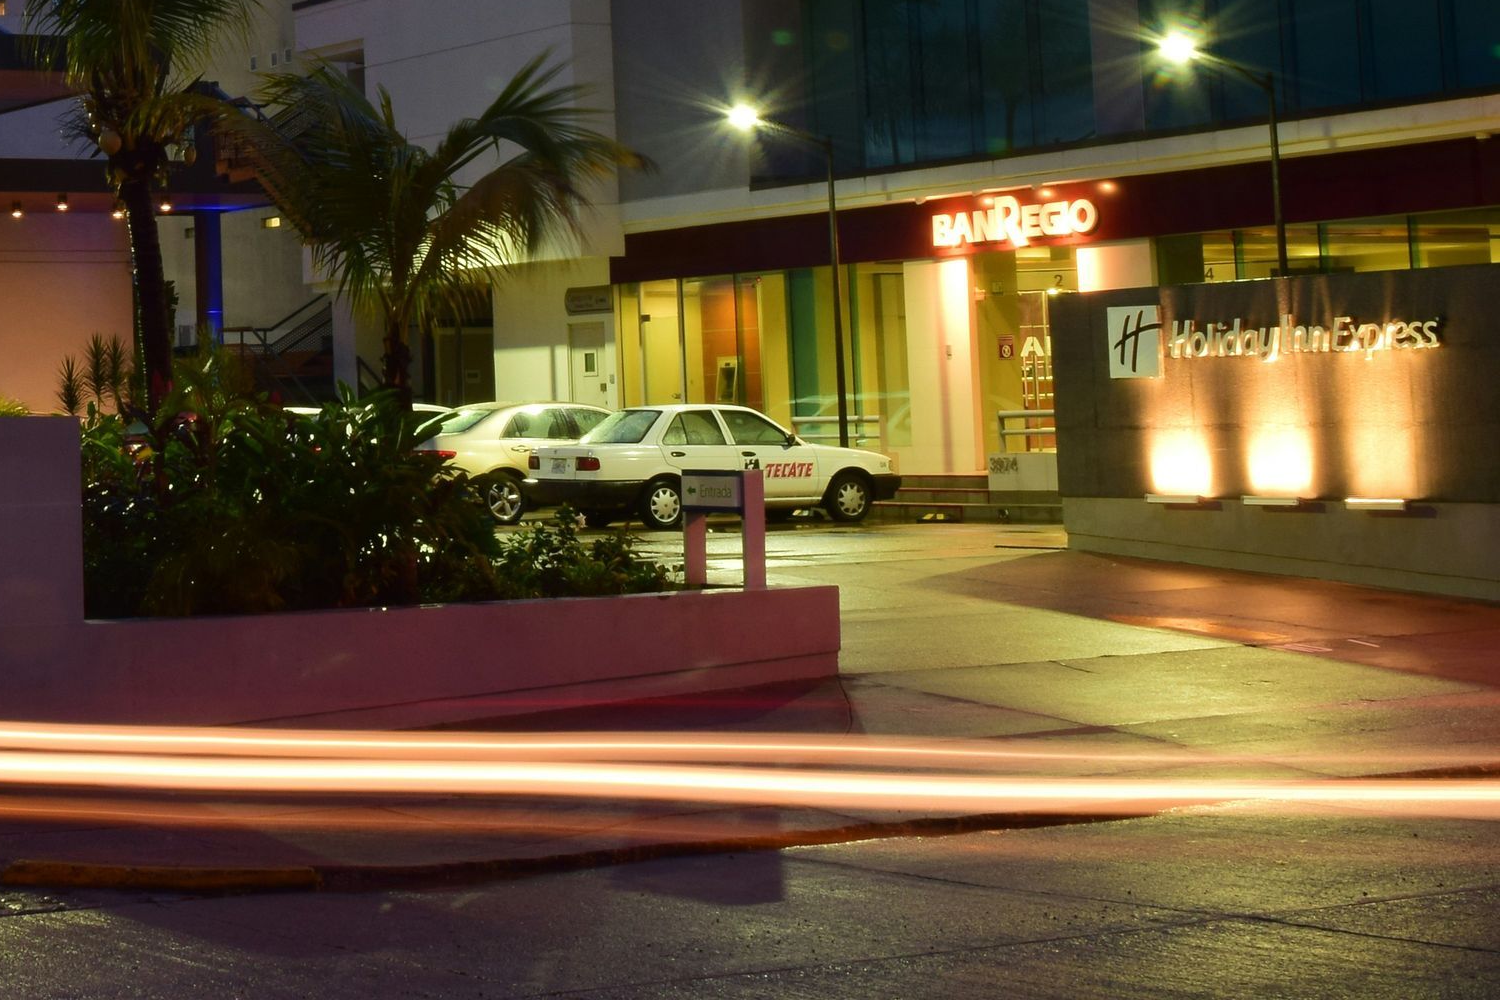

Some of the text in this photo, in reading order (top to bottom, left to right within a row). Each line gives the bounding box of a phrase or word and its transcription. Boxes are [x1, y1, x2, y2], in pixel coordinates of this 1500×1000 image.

[1053, 274, 1064, 287] 2
[1168, 314, 1441, 363] Holiday Inn Express
[766, 462, 813, 478] TECATE
[700, 482, 732, 498] Entrada
